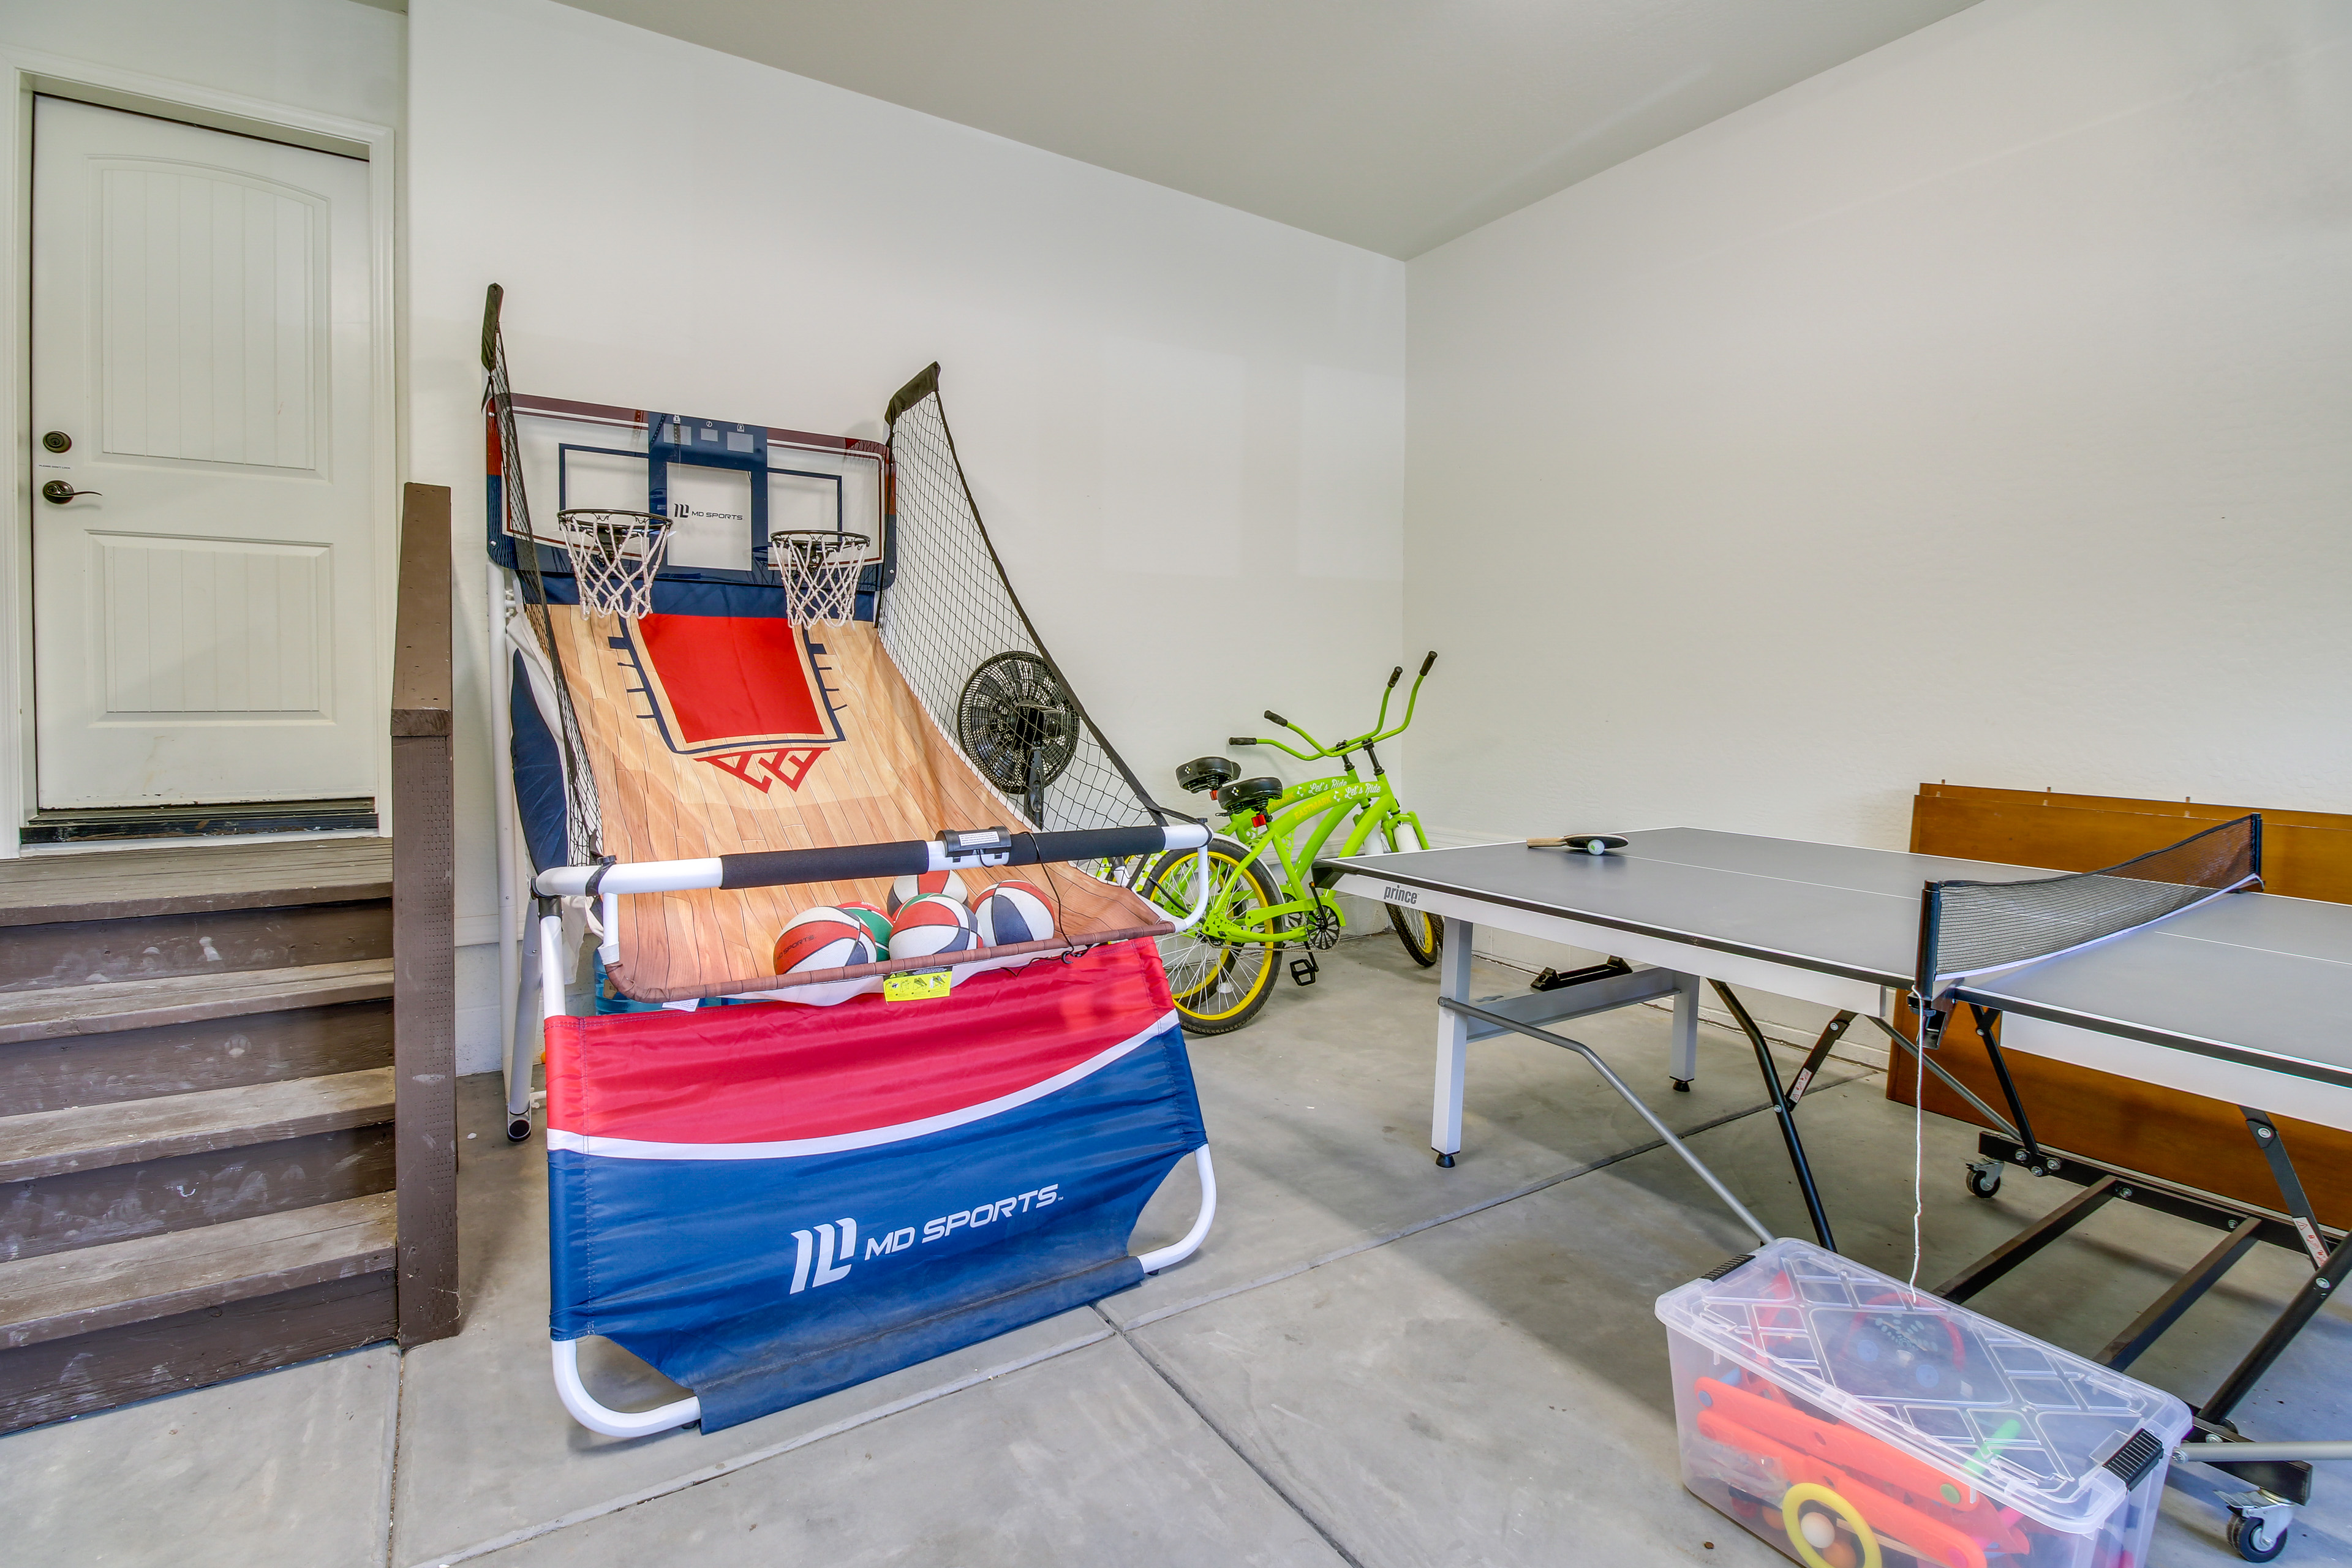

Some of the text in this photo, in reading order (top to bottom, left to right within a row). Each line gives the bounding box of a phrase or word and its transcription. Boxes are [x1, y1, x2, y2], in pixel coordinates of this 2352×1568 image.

[706, 512, 743, 521] SPORTS
[1308, 782, 1329, 795] Let's
[1344, 783, 1381, 799] Let's Ride
[1294, 796, 1332, 820] EASTMARK
[1383, 884, 1417, 905] prince
[783, 935, 815, 955] SPORTS
[864, 1226, 915, 1261] MD
[921, 1183, 1058, 1244] SPORTS
